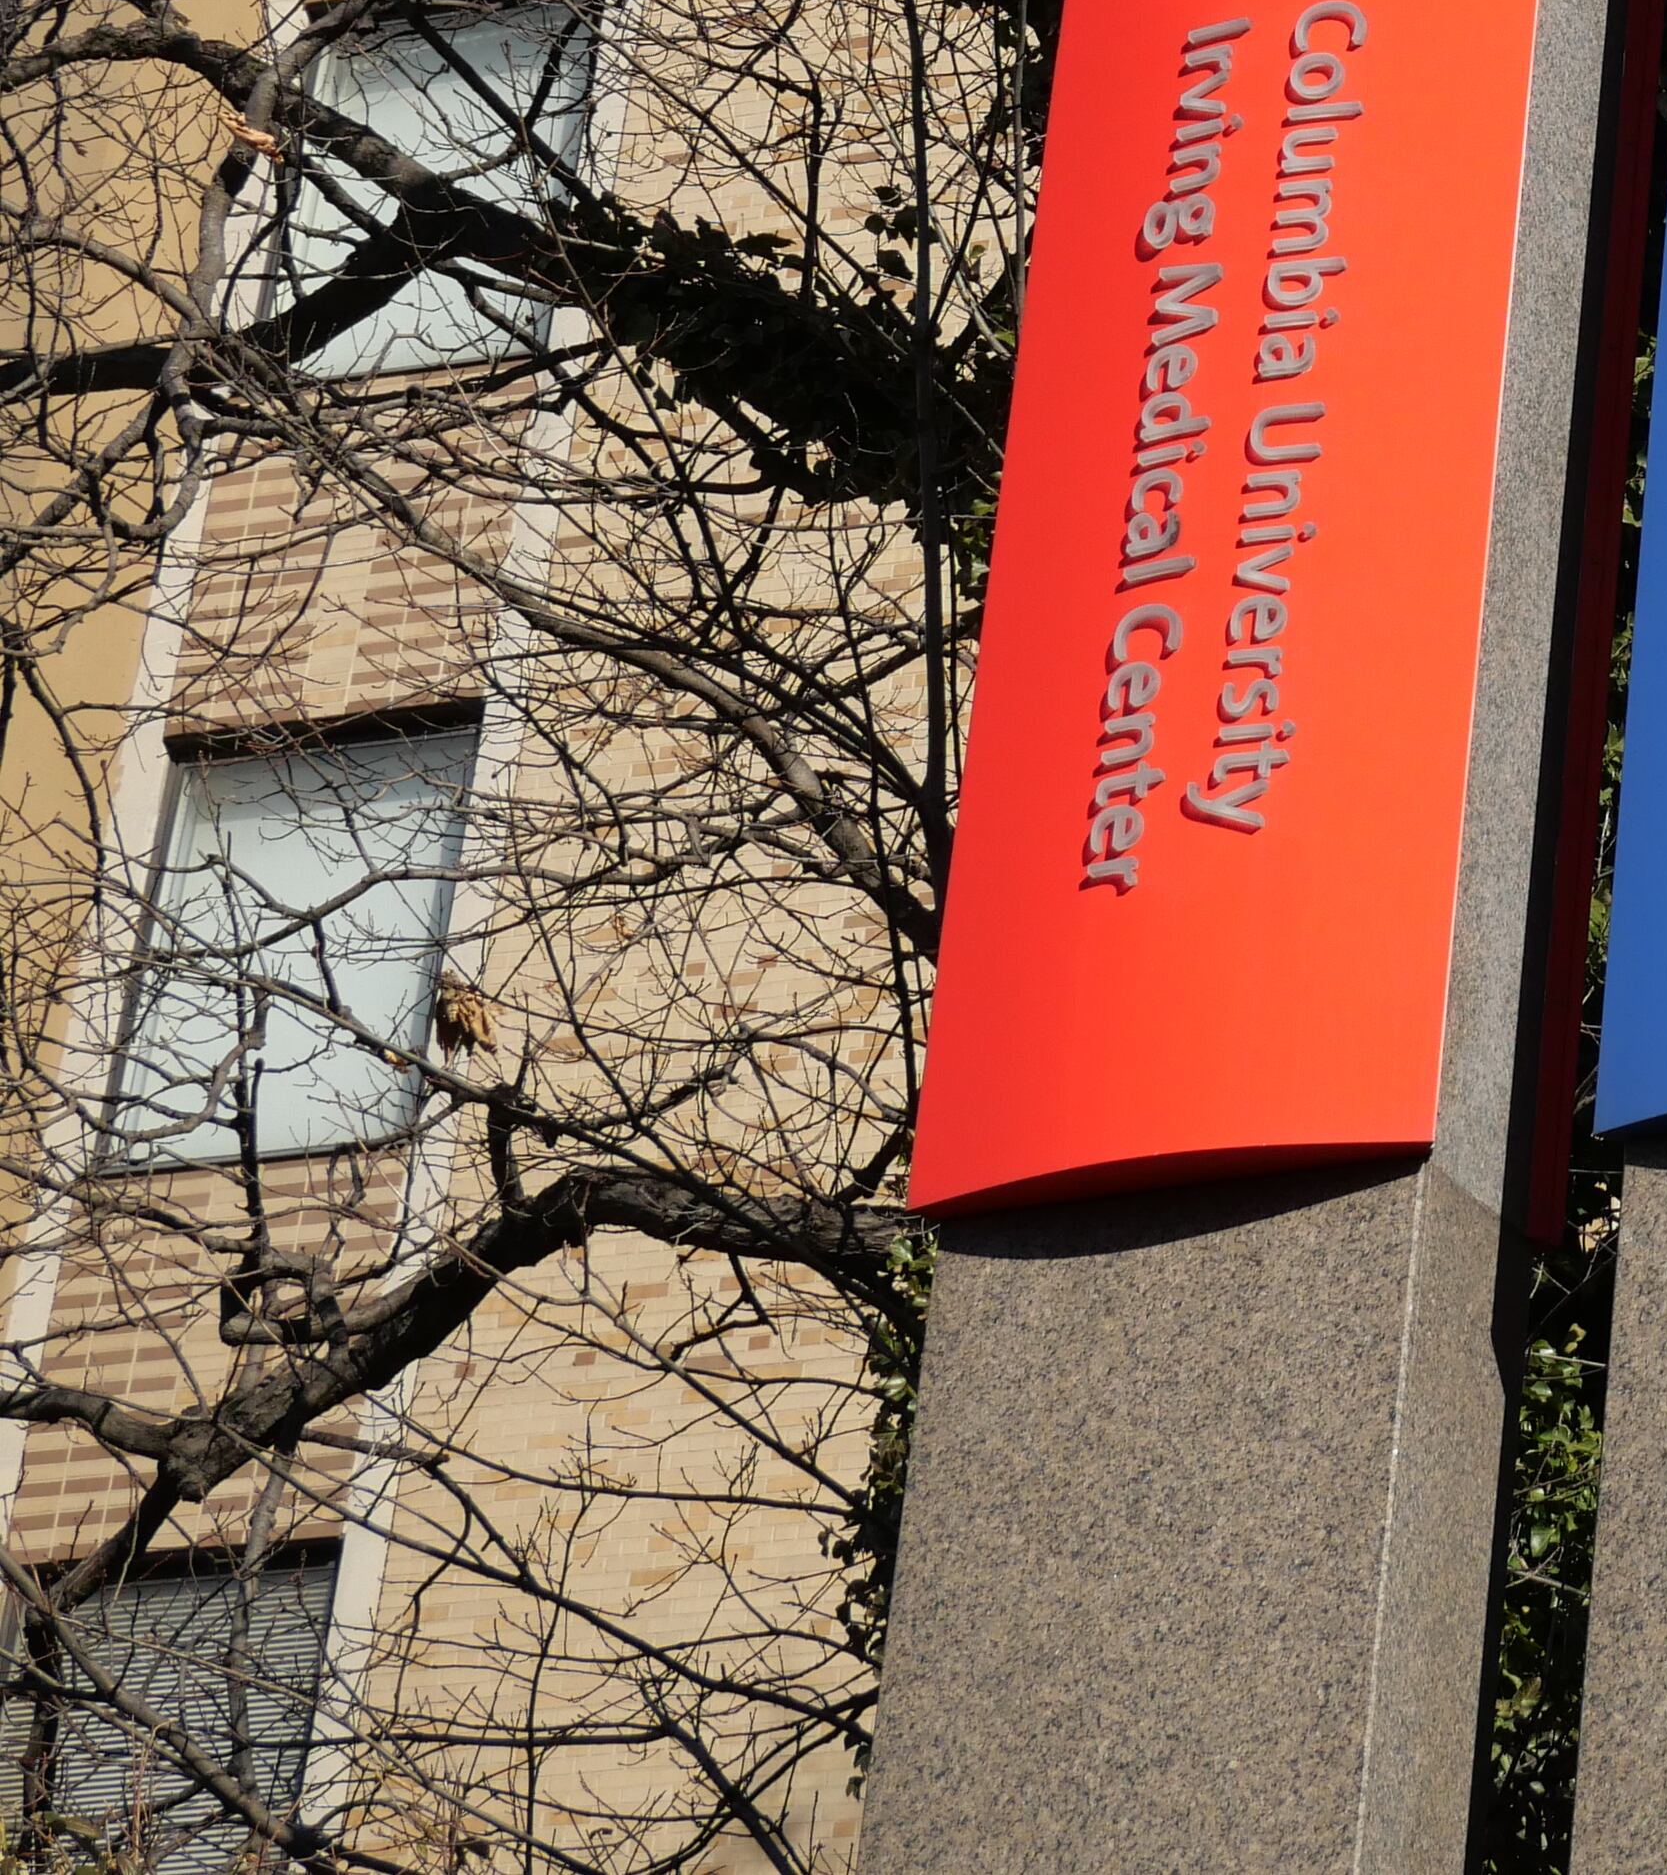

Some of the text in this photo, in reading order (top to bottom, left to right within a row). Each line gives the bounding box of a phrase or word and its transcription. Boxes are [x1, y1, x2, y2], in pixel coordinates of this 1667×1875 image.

[1087, 17, 1252, 886] Irving Medical Center
[1187, 0, 1368, 830] Columbia University
